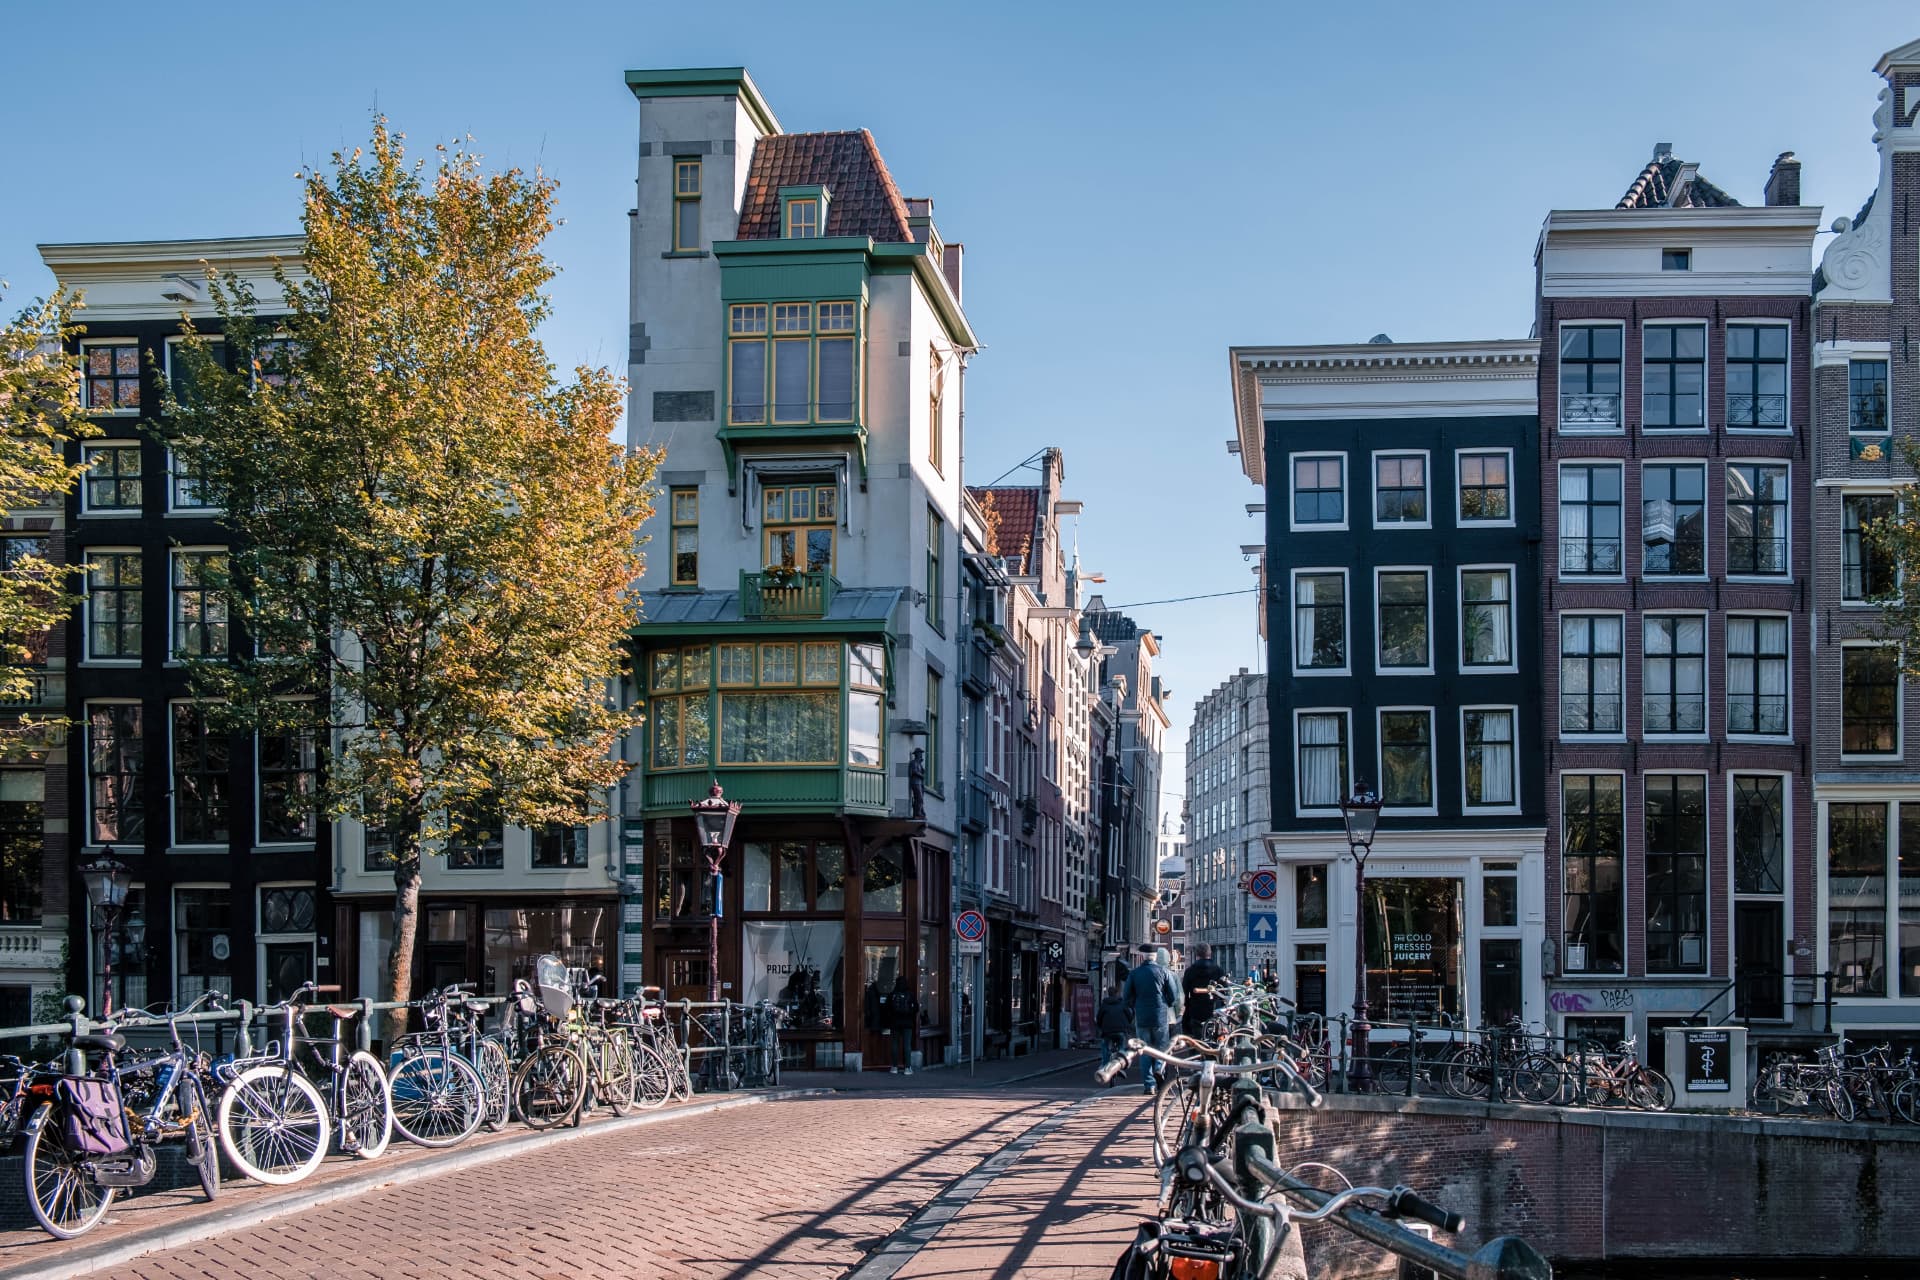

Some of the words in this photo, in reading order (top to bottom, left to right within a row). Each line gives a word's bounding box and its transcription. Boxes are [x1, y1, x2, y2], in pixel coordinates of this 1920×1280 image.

[1406, 933, 1432, 941] COLD
[1394, 943, 1432, 951] PRESSED
[1394, 952, 1432, 960] JUICERY
